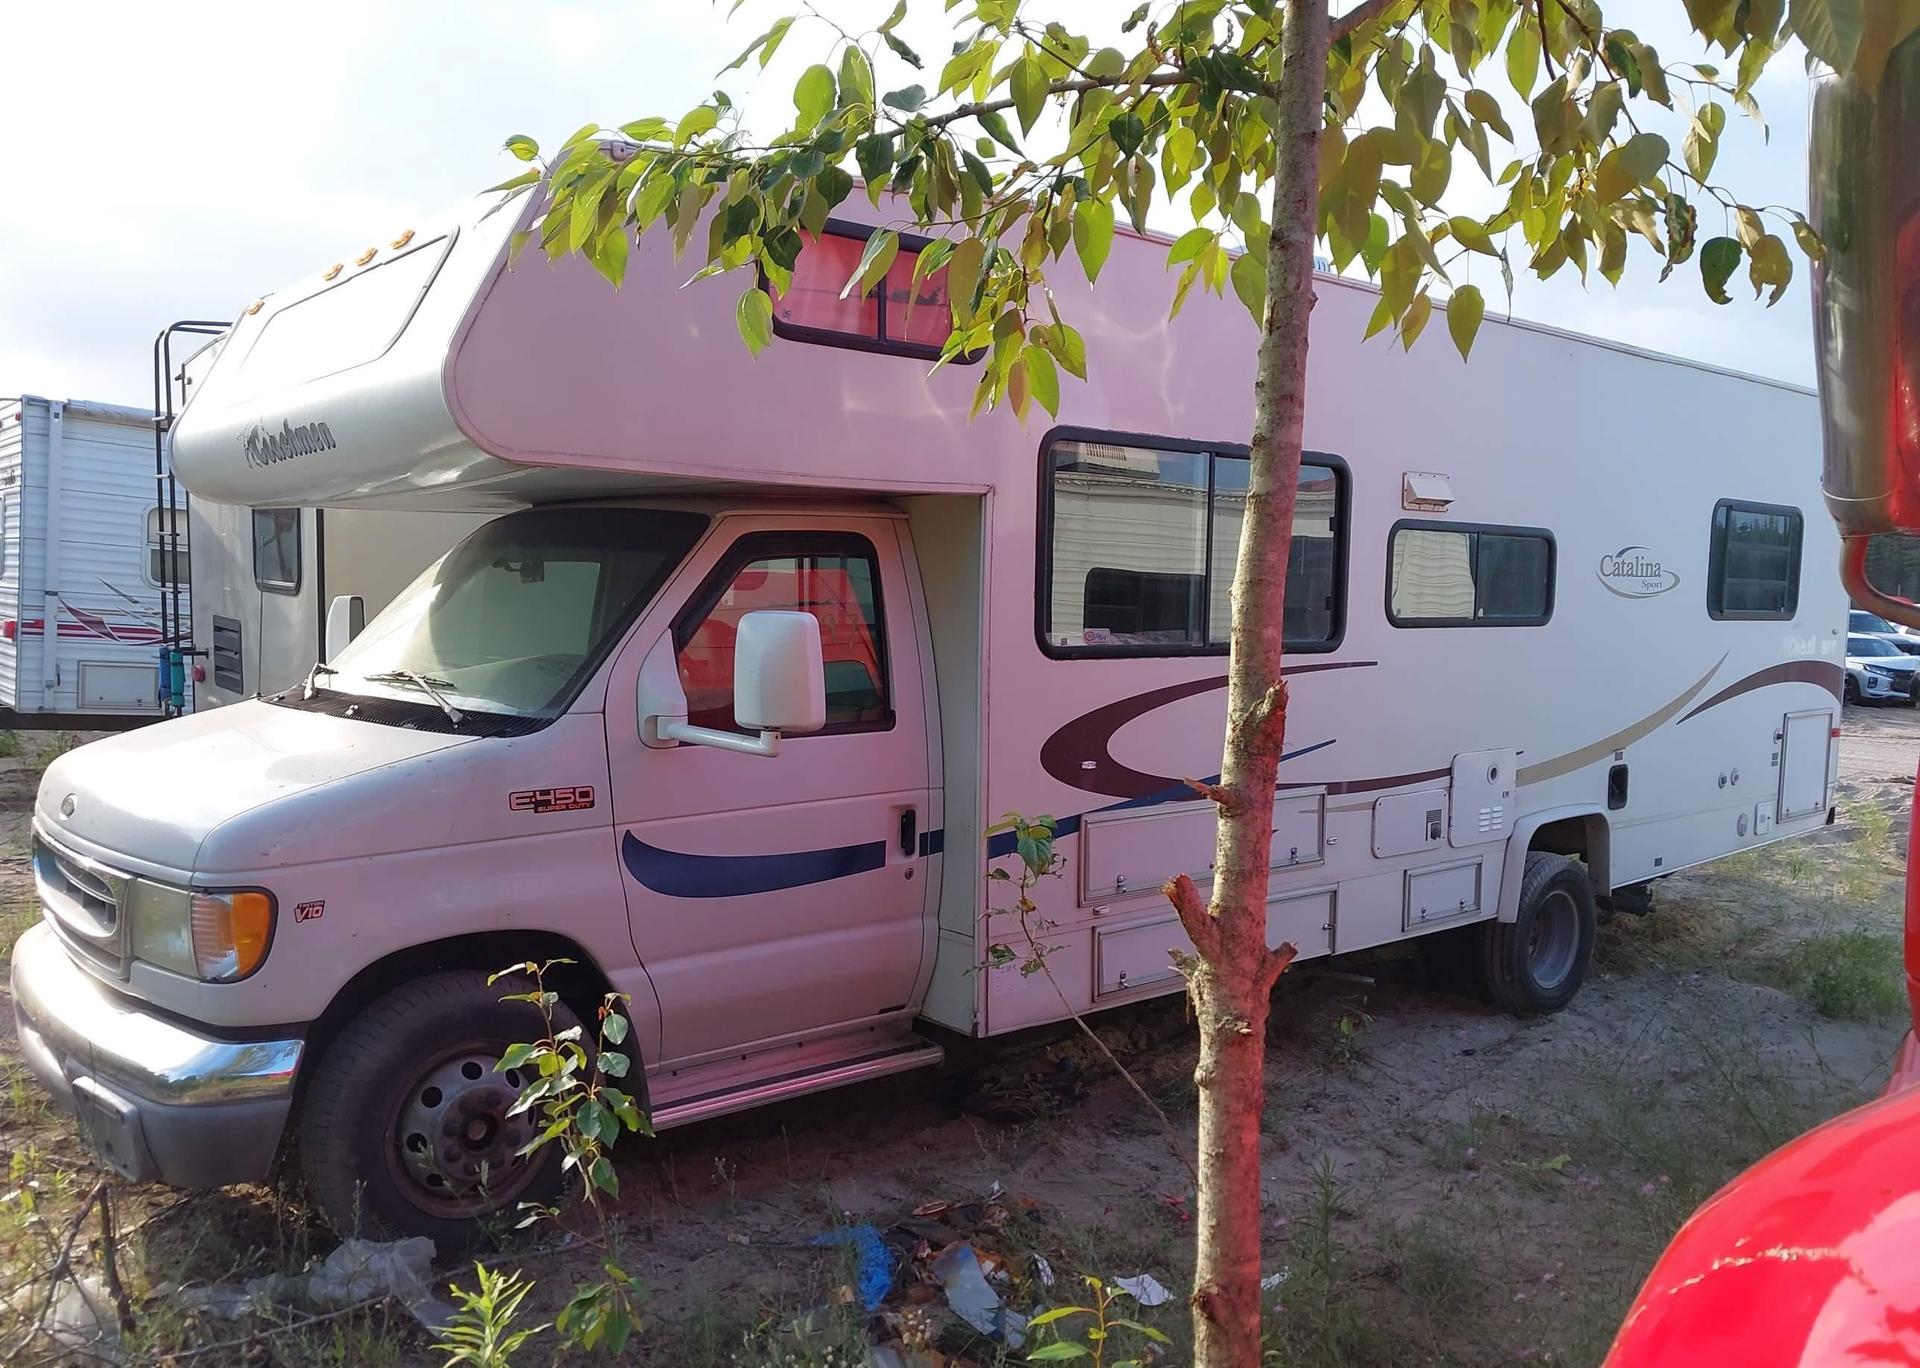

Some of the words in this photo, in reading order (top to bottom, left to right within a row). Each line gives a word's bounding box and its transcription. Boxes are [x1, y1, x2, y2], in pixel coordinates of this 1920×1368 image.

[246, 418, 336, 465] Coachmen
[1600, 555, 1661, 577] Catalina
[1641, 580, 1663, 590] Sport
[537, 803, 567, 812] SUPER
[295, 906, 323, 922] V10
